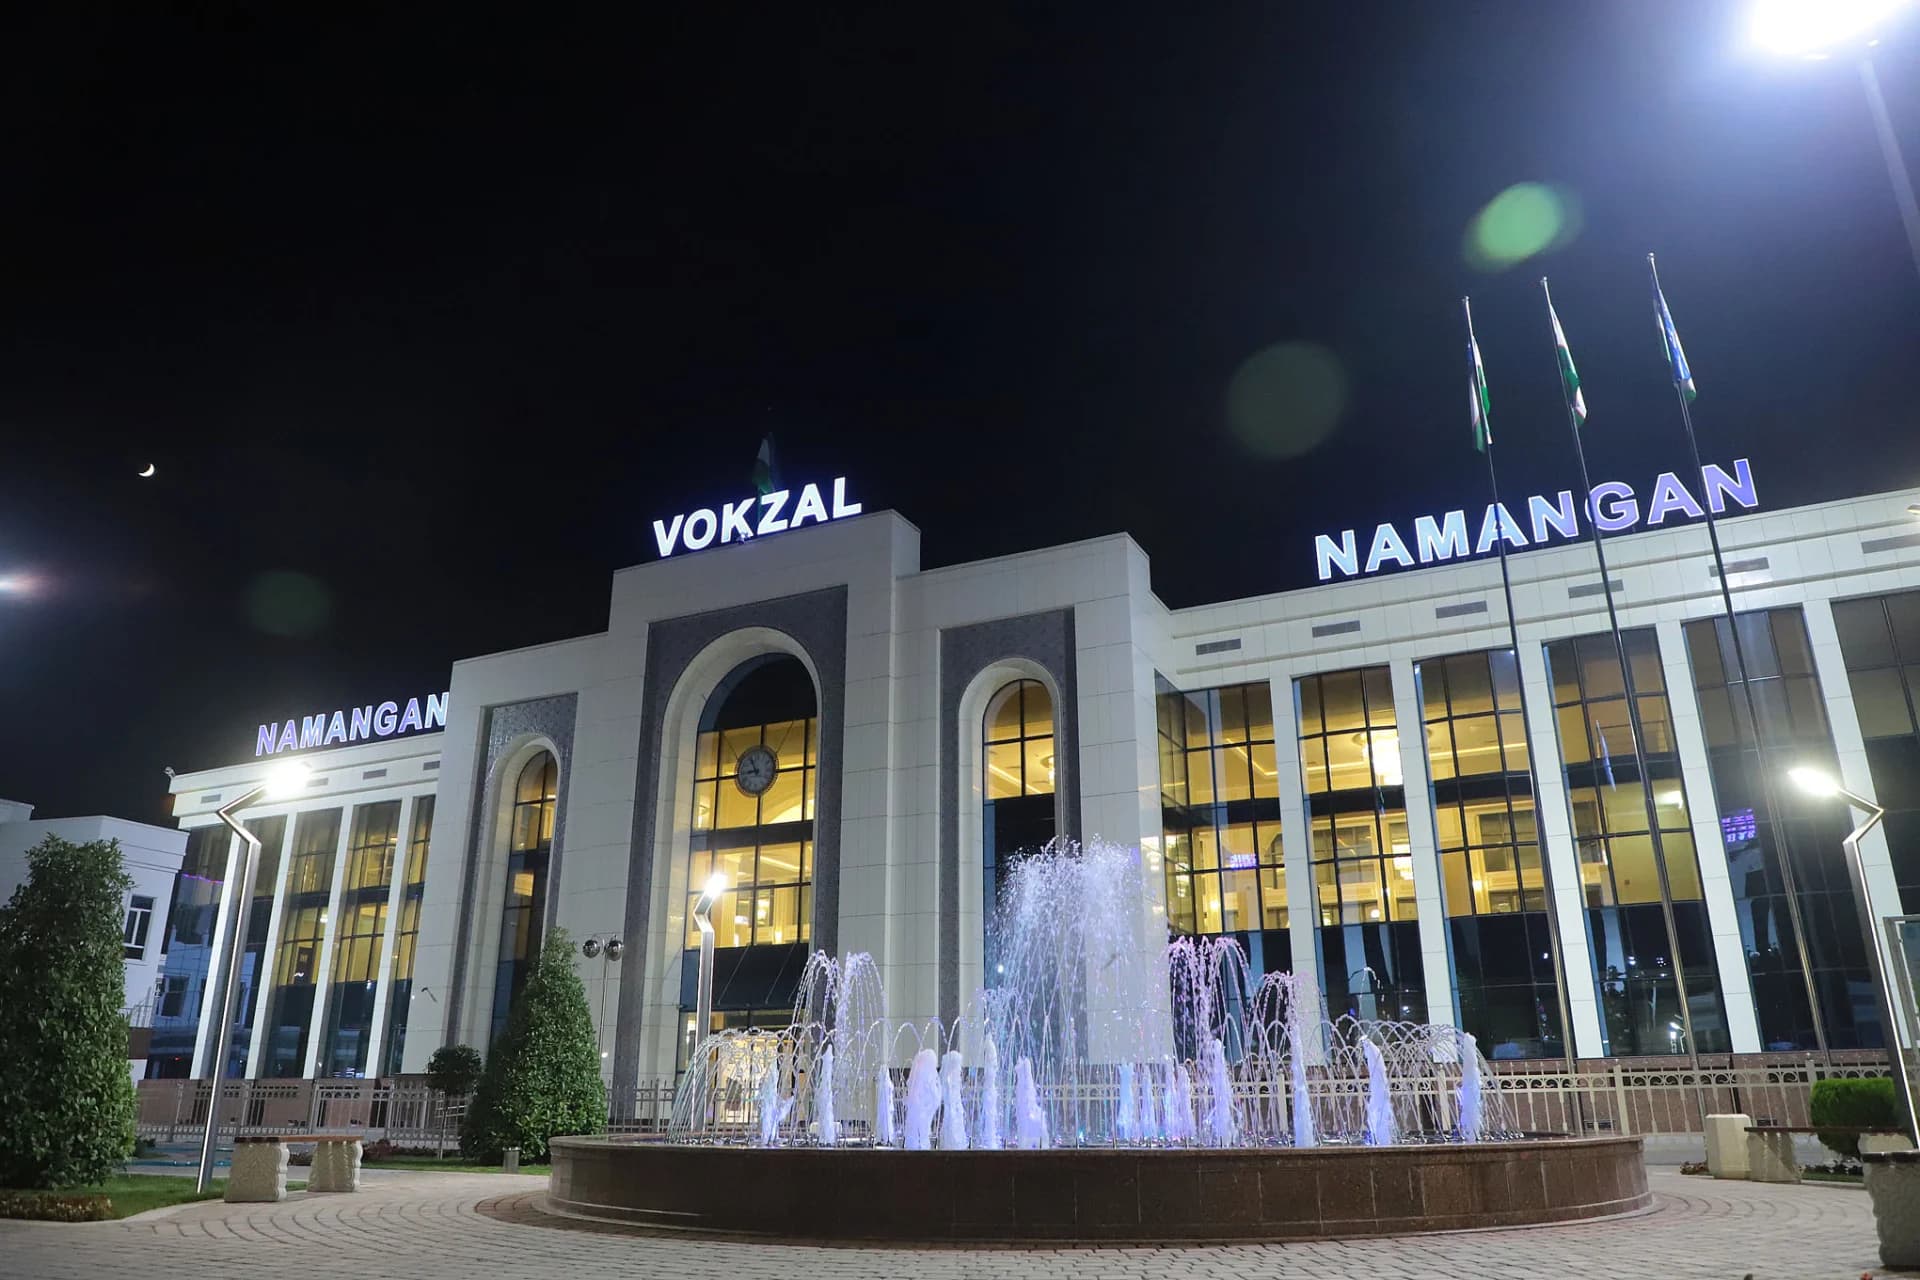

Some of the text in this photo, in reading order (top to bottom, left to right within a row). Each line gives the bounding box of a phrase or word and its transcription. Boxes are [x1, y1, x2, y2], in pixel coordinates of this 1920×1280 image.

[653, 477, 862, 557] VOKZAL
[1314, 459, 1759, 580] NAMANGAN
[256, 691, 450, 757] NAMANGAN
